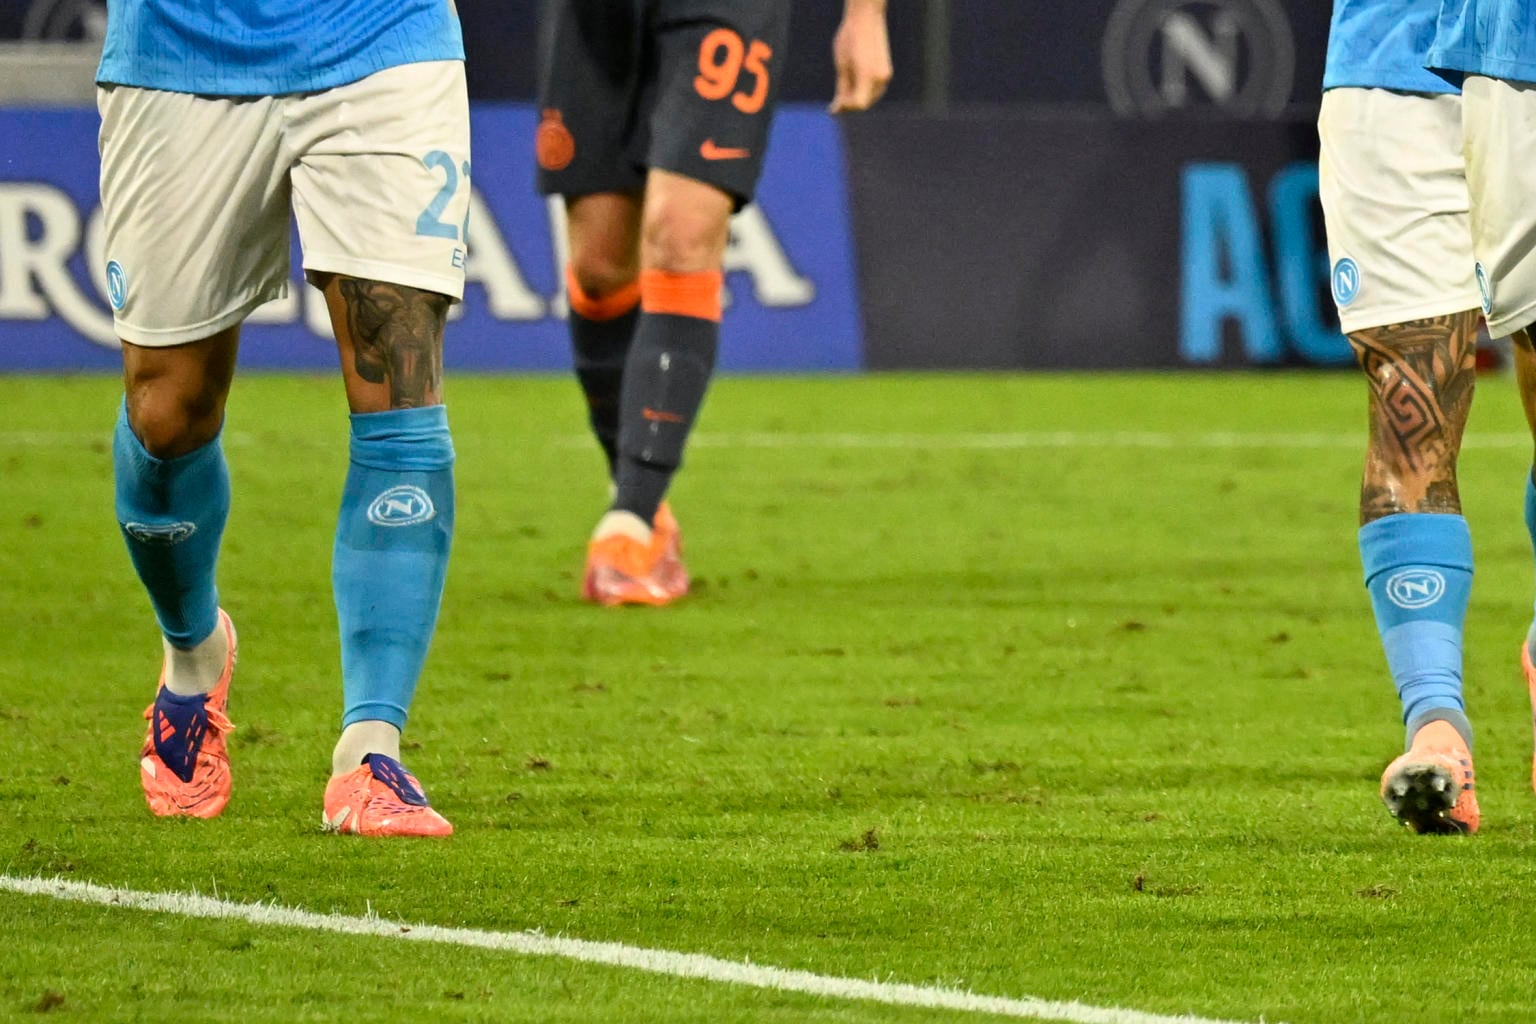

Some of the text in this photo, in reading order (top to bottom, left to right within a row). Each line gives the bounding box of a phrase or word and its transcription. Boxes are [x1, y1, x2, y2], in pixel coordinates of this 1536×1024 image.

[693, 27, 773, 115] 95
[1159, 8, 1239, 108] N
[415, 149, 471, 246] 2
[1339, 269, 1353, 294] N
[1401, 579, 1430, 599] N
